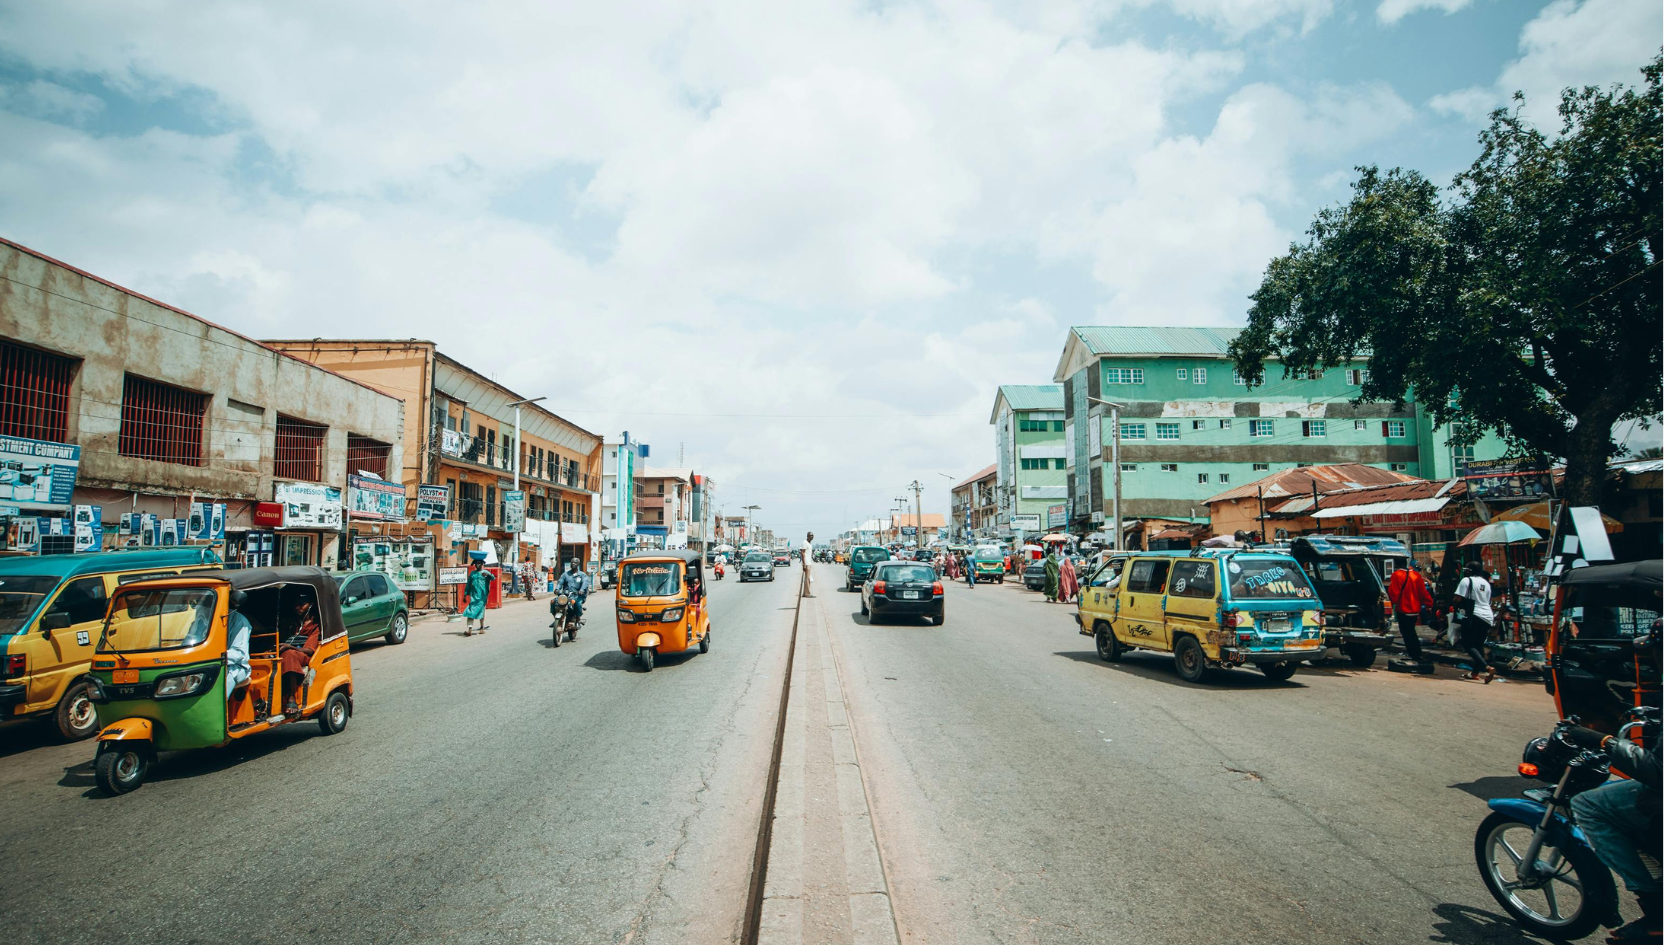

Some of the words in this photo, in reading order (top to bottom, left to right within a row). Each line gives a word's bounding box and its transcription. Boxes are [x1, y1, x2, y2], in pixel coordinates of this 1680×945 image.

[35, 443, 75, 459] COMPANY
[292, 487, 326, 495] IMPRESSION
[420, 488, 448, 498] POLYSTR
[256, 510, 280, 519] Canon
[1245, 566, 1285, 588] TARKO
[76, 632, 89, 645] 99
